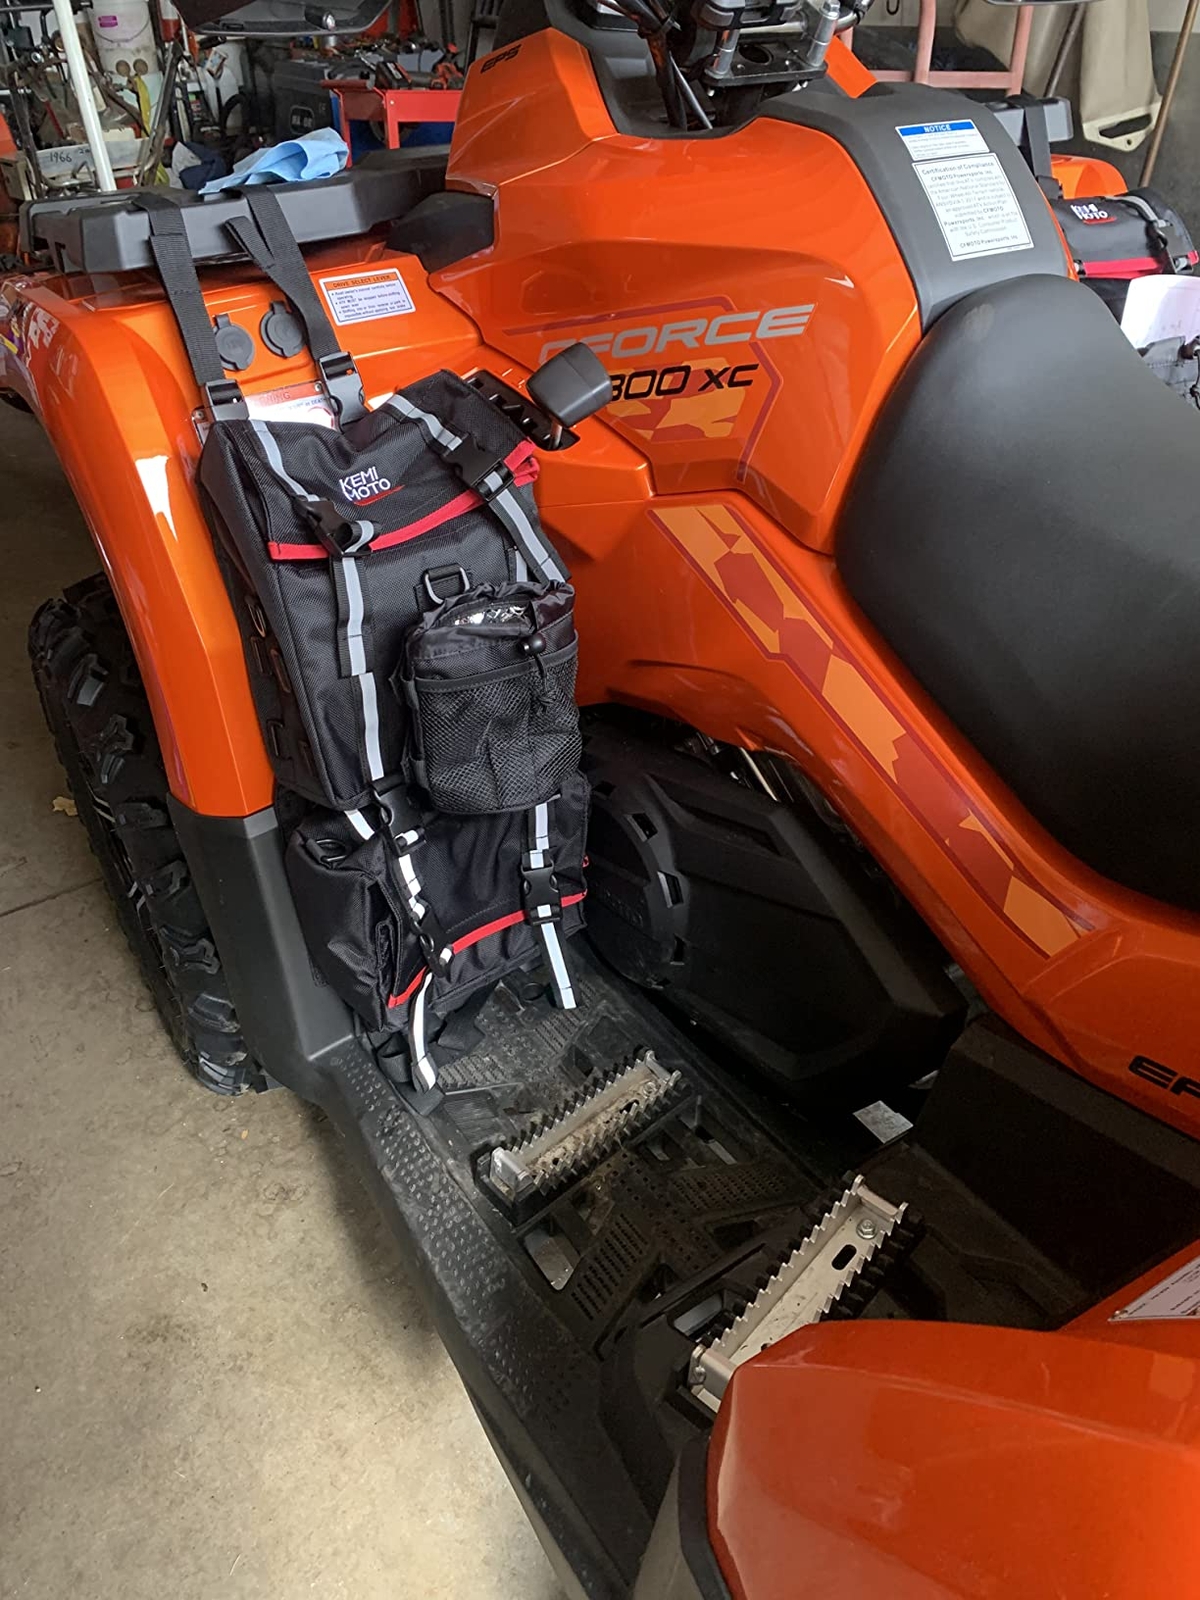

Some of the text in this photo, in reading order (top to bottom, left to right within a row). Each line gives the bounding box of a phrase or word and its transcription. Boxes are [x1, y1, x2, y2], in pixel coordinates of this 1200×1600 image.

[480, 44, 522, 74] EPS
[924, 124, 951, 132] NOTICE
[921, 165, 957, 175] Certification
[963, 160, 994, 169] Compliance
[697, 363, 760, 393] XC
[339, 466, 379, 491] KEMI
[344, 478, 391, 501] MOTO
